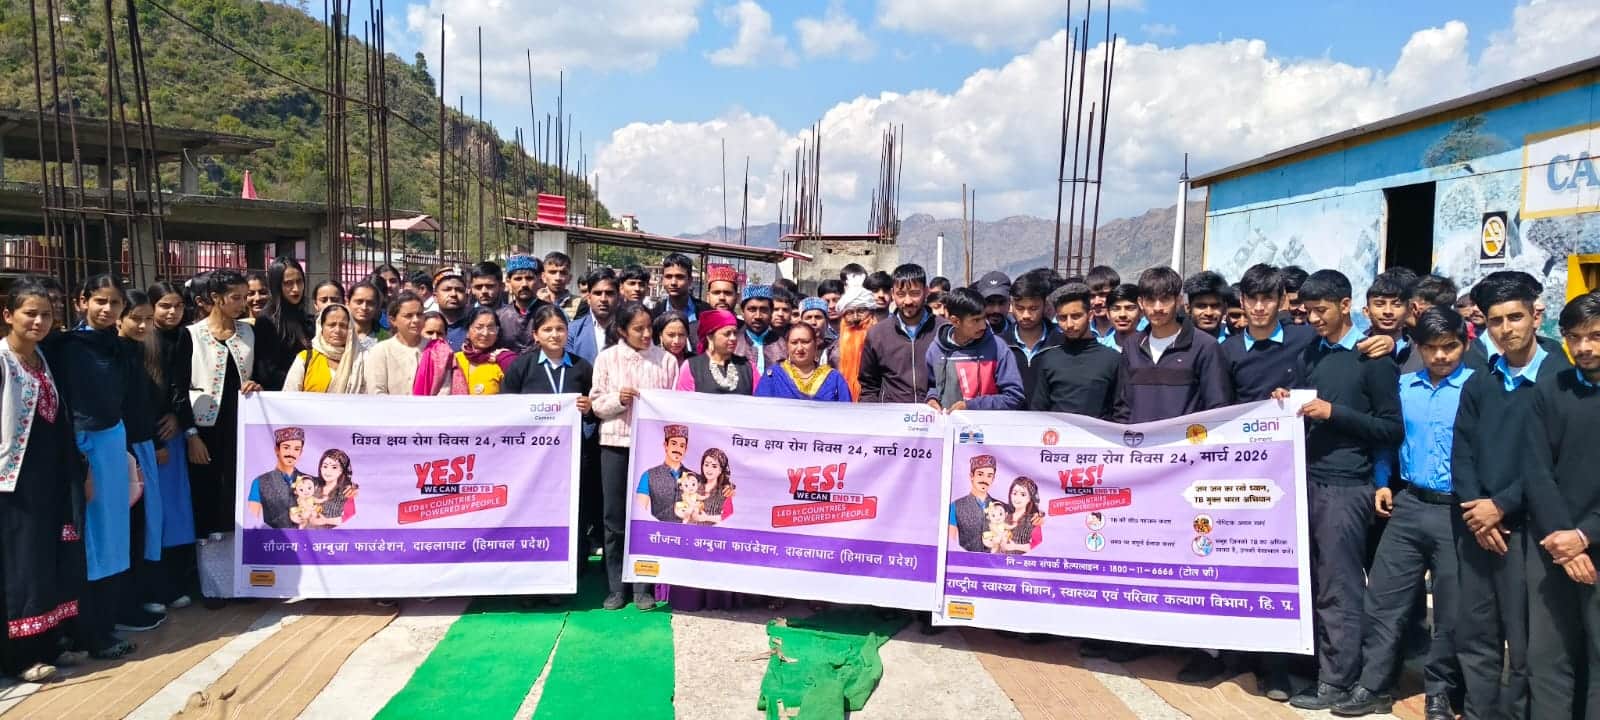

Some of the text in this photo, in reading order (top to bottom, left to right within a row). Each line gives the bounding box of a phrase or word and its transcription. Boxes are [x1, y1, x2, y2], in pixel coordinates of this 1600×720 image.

[530, 402, 561, 412] adani
[903, 412, 935, 423] adani
[1242, 418, 1280, 433] adani
[352, 432, 561, 448] विश्व क्षय रोग दिवस 24, मार्च 2026
[732, 434, 932, 459] विश्व क्षय रोग दिवस 24, मार्च 2026
[1040, 446, 1268, 465] विश्व क्षय रोग दिवस 24, मार्च 2026
[414, 454, 475, 489] YES!
[787, 462, 847, 494] YES!
[1058, 464, 1105, 490] YES!
[404, 503, 420, 513] LED
[430, 495, 476, 509] COUNTRIES
[796, 491, 809, 499] WE
[810, 492, 828, 501] CAN
[420, 504, 460, 518] POWERED
[471, 498, 500, 509] PEOPLE
[777, 509, 792, 517] LED
[801, 503, 847, 515] COUNTRIES
[793, 513, 831, 523] POWERED
[841, 508, 870, 519] PEOPLE
[263, 539, 298, 552] सौजन्य
[312, 541, 349, 555] अम्बुजा
[472, 537, 515, 552] (हिमाचल
[520, 536, 550, 552] प्रदेश)
[649, 531, 681, 545] सौजन्य
[694, 537, 726, 553] अम्बुजा
[840, 549, 882, 565] (हिमाचल
[888, 552, 918, 570] प्रदेश)
[1040, 558, 1060, 569] संपर्क
[1179, 566, 1198, 577] (टोल
[946, 576, 977, 593] राष्ट्रीय
[982, 582, 1016, 594] स्वास्थ्य
[1021, 581, 1056, 599] मिशन,
[1060, 586, 1097, 600] स्वास्थ्य
[1102, 588, 1120, 603] एवं
[1123, 588, 1159, 604] परिवार
[1163, 593, 1205, 607] कल्याण
[1210, 593, 1254, 611] विभाग,
[1258, 593, 1276, 611] हि.
